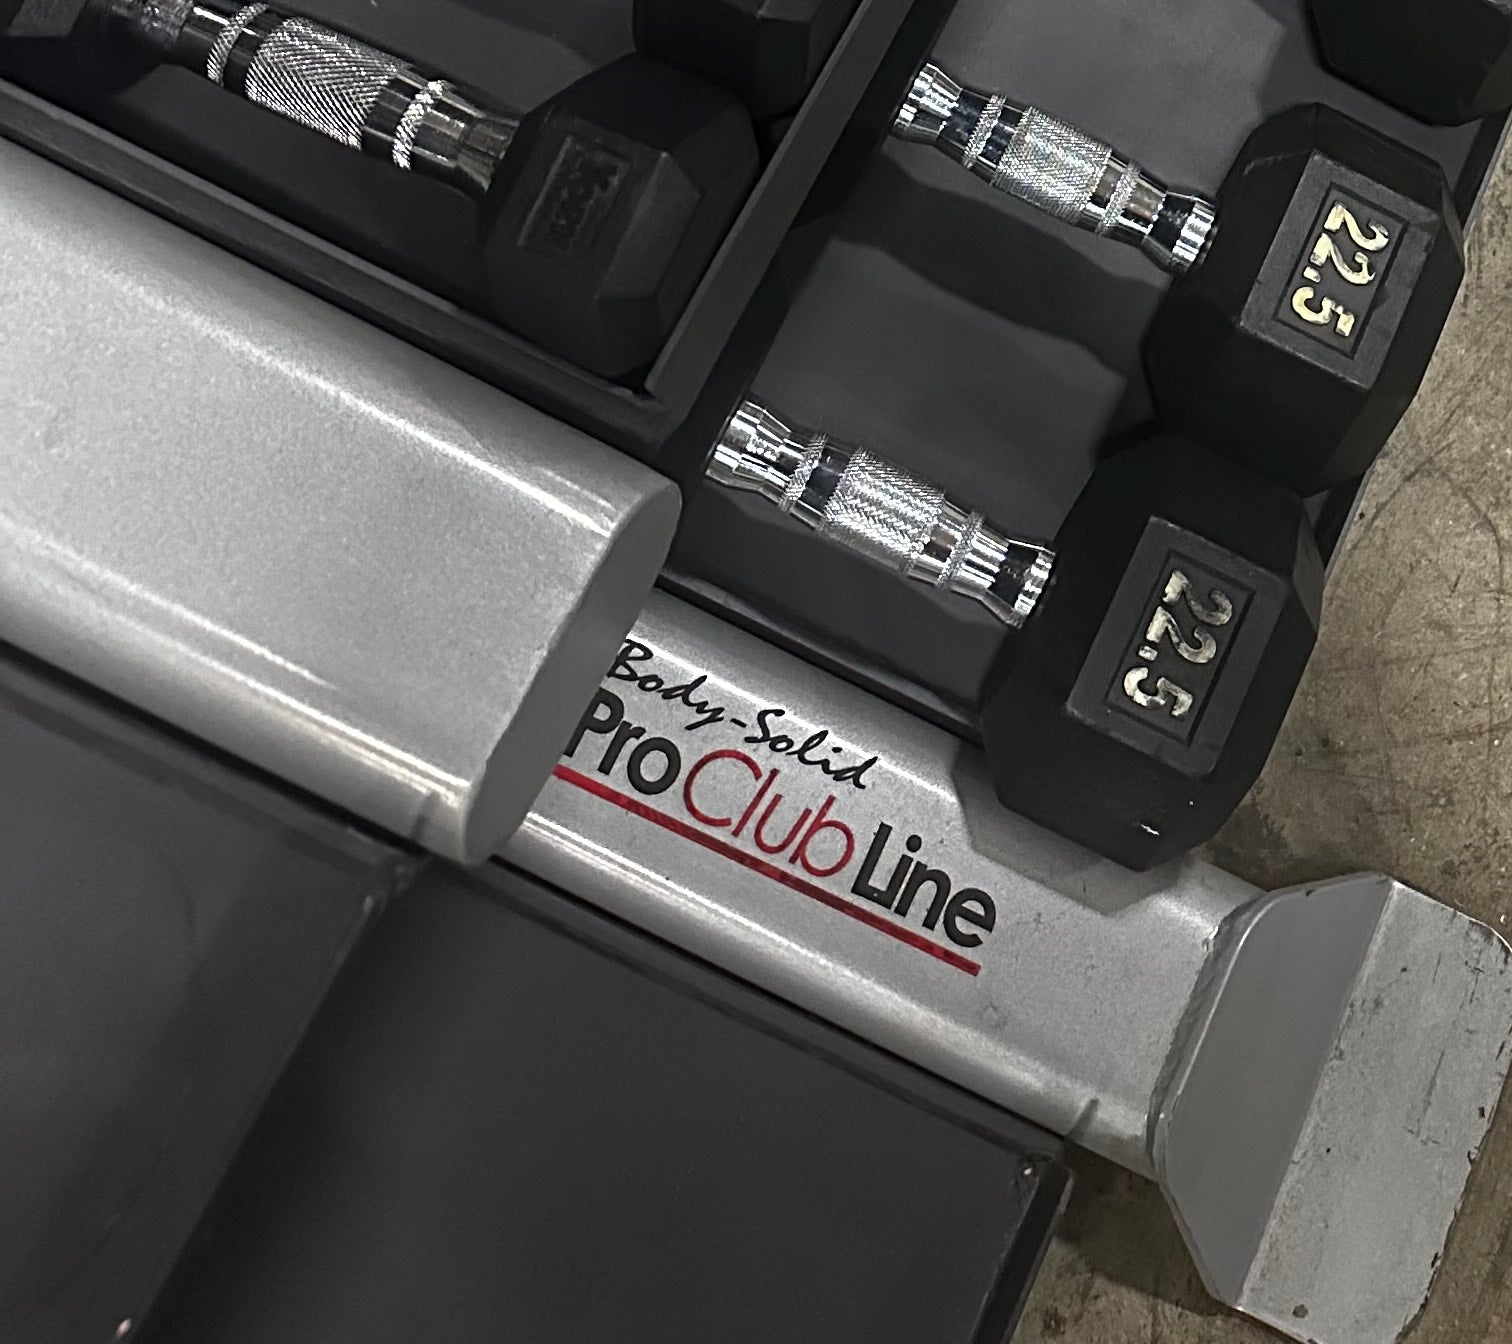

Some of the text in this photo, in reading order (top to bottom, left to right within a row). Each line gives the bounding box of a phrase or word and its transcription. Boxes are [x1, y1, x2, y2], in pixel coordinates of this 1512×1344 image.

[1293, 205, 1388, 336] 22.5
[607, 638, 881, 791] Body-Solid
[1124, 571, 1232, 716] 22.5
